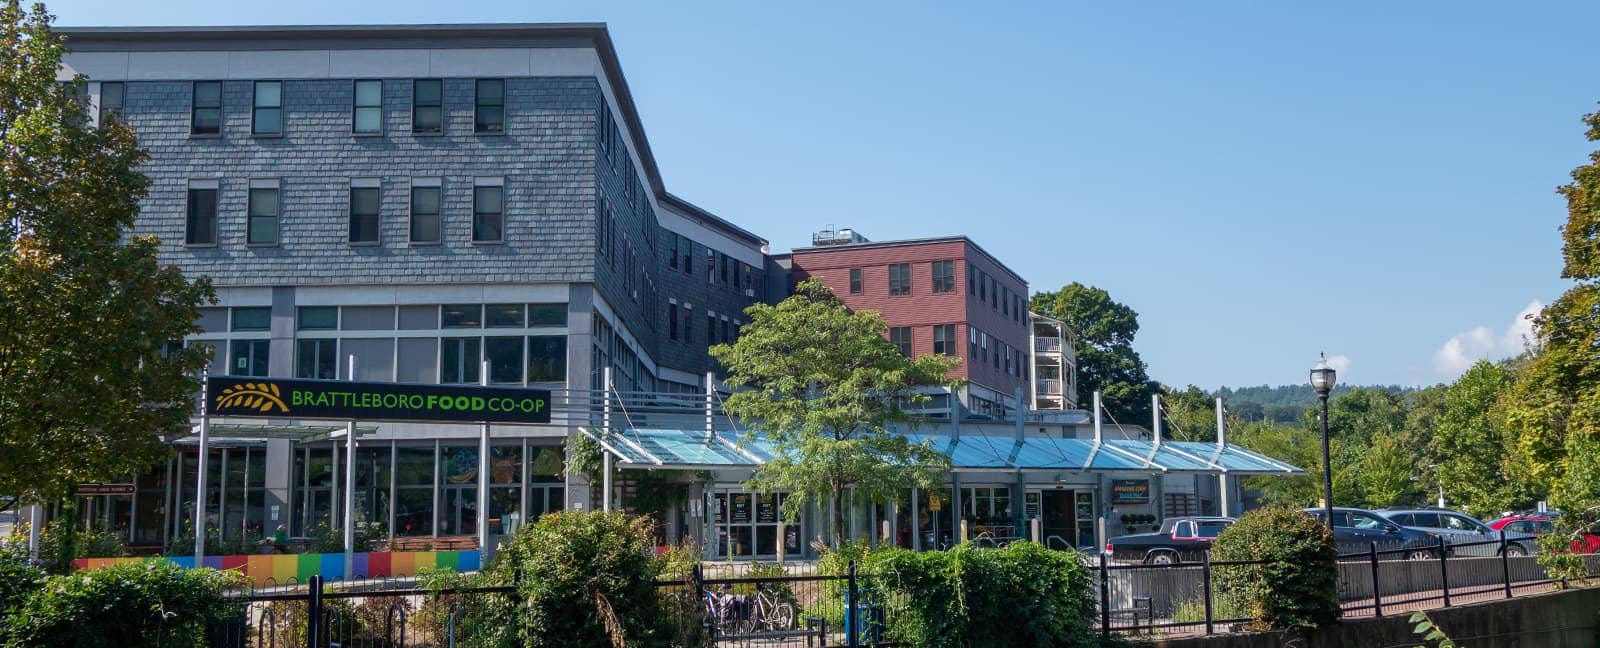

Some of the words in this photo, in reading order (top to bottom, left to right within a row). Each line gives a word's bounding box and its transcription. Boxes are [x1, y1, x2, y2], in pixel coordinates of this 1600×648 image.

[292, 390, 424, 409] BRATTLEBORO
[427, 395, 486, 411] FOOD
[488, 397, 545, 413] CO-OP
